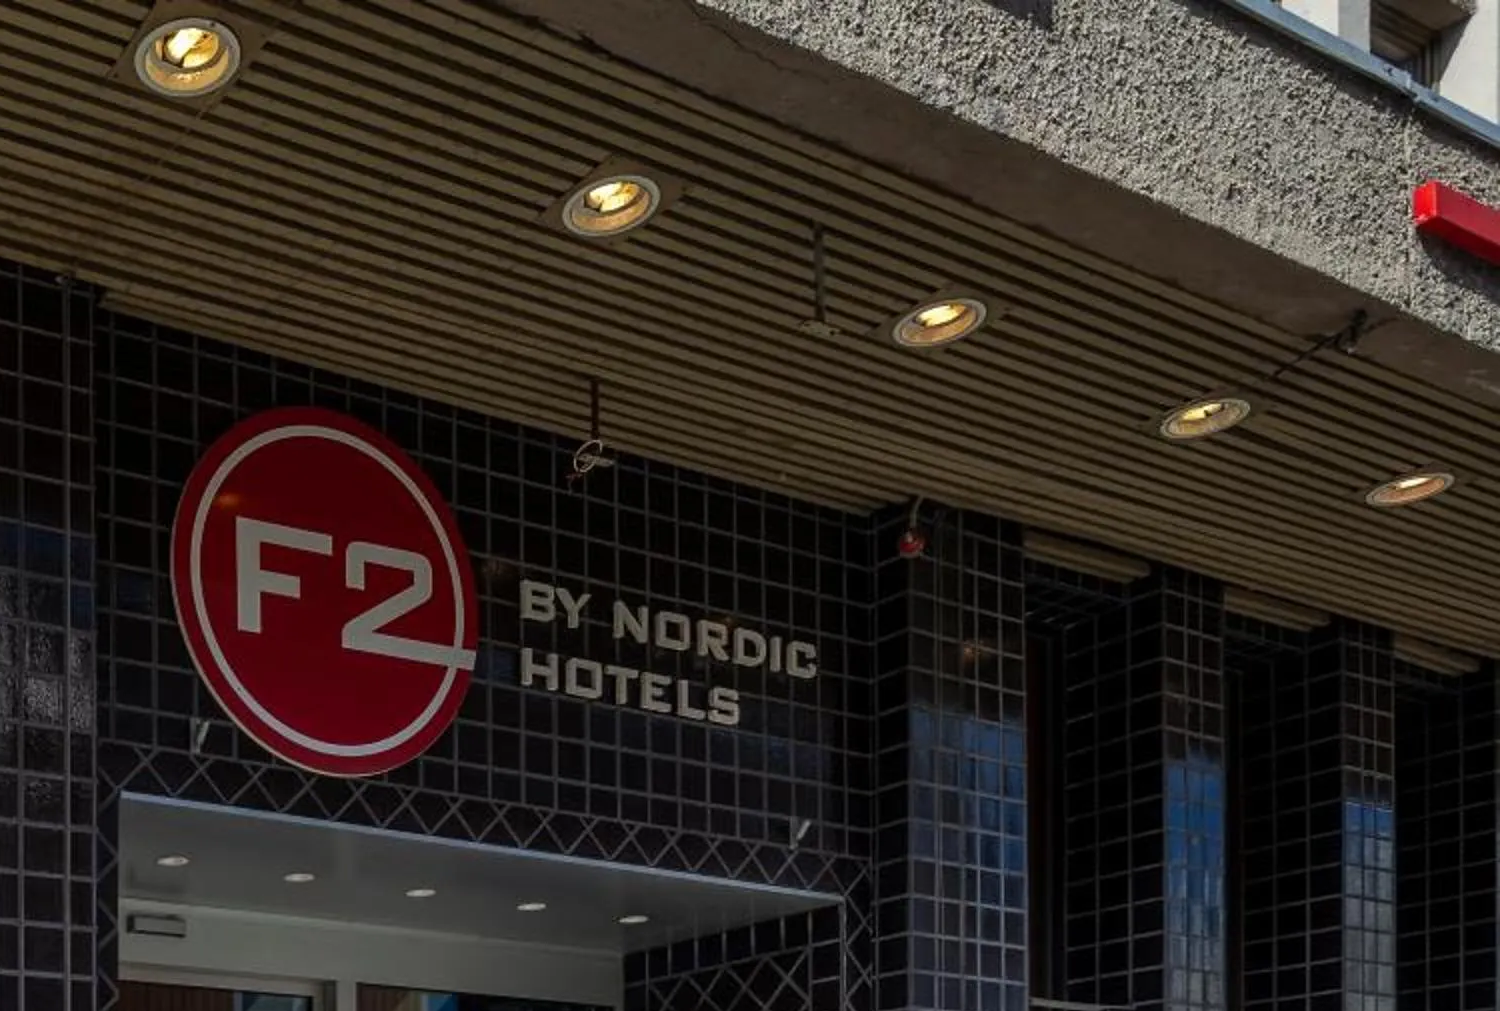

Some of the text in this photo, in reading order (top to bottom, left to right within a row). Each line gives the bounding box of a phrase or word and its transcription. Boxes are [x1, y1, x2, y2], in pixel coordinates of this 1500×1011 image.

[234, 515, 477, 672] F2
[520, 578, 819, 680] BY NORDIC
[520, 647, 741, 727] HOTELS
